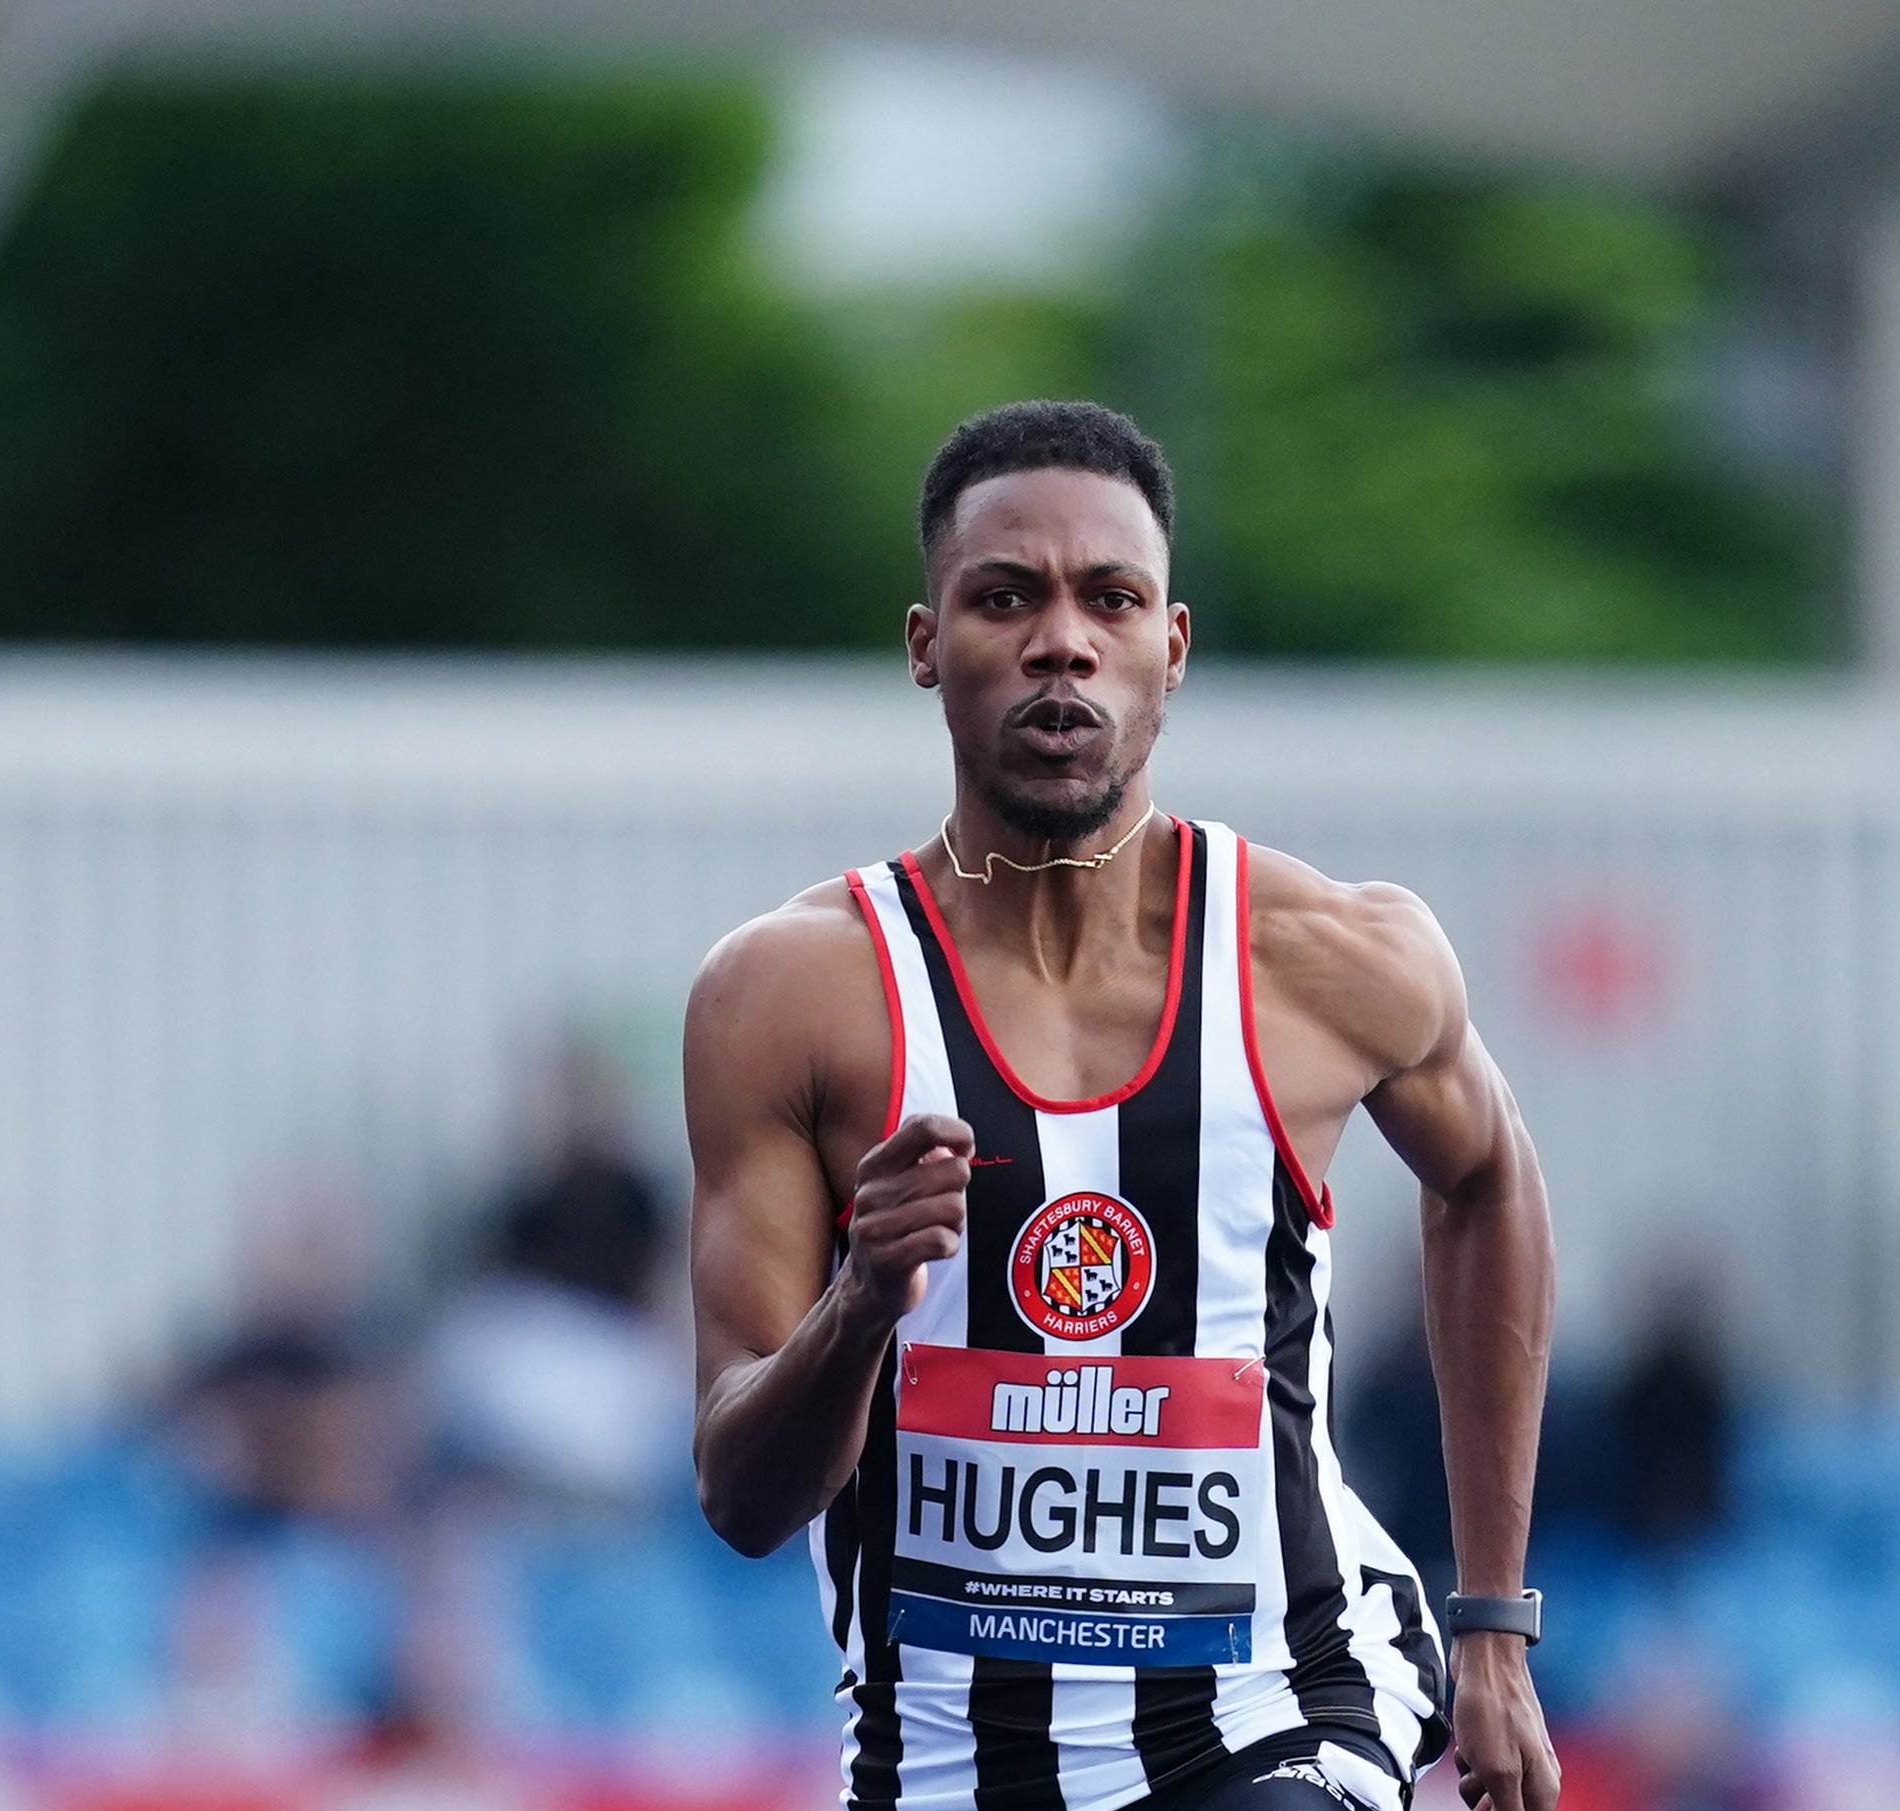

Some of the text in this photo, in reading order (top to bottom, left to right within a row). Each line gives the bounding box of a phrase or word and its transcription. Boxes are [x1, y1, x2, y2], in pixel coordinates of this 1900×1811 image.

[1020, 1199, 1145, 1264] SHAFTESBURY BARNET
[1043, 1310, 1117, 1334] HARRIERS
[991, 1365, 1169, 1436] müller
[908, 1452, 1241, 1560] HUGHES
[965, 1581, 1174, 1606] #WHERE IT STARTS
[969, 1613, 1165, 1649] MANCHESTER
